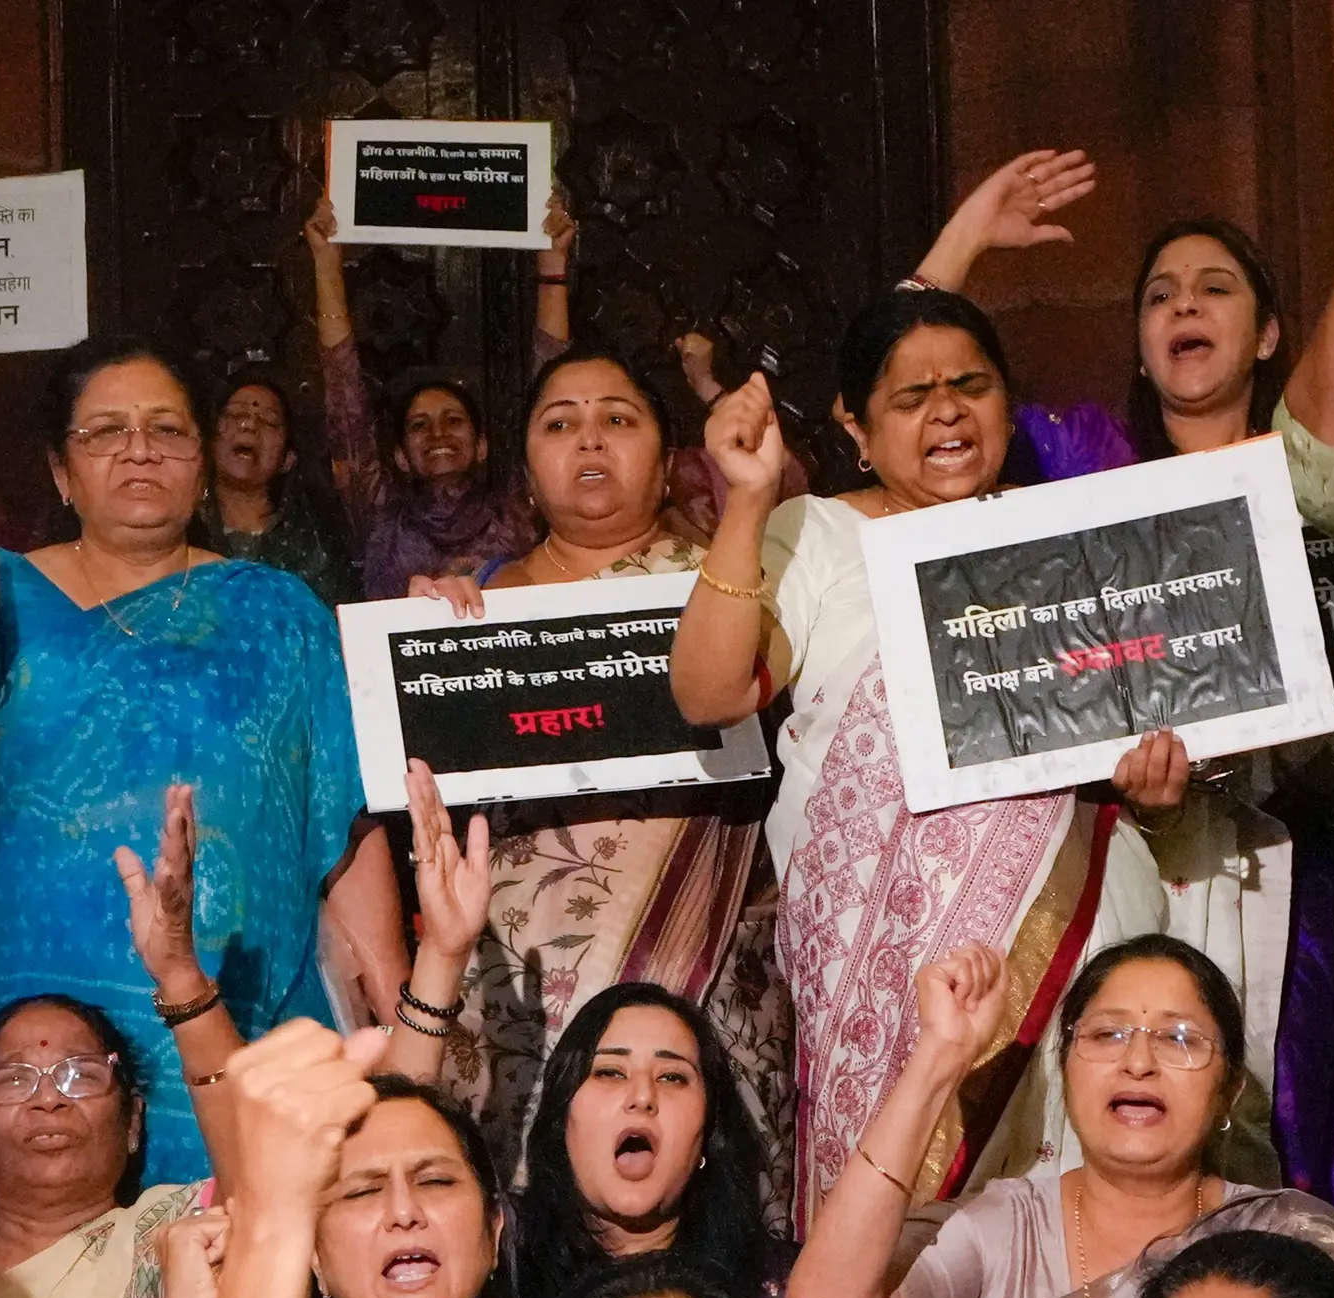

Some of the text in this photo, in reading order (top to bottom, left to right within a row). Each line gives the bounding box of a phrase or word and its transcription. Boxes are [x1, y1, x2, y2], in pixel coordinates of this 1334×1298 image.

[18, 208, 35, 222] का
[943, 568, 1241, 640] महिला का हक दिलाए सरकार,
[398, 640, 437, 657] ढोंग
[439, 638, 457, 654] की
[460, 630, 536, 651] राजनीति,
[539, 627, 585, 647] दिखावे
[588, 628, 606, 640] का
[963, 624, 1243, 696] विपक्ष बने रुकावट हर बार!
[402, 651, 669, 697] महिलाओं के हक़ पर कांग्रेस
[508, 704, 604, 736] प्रहार!
